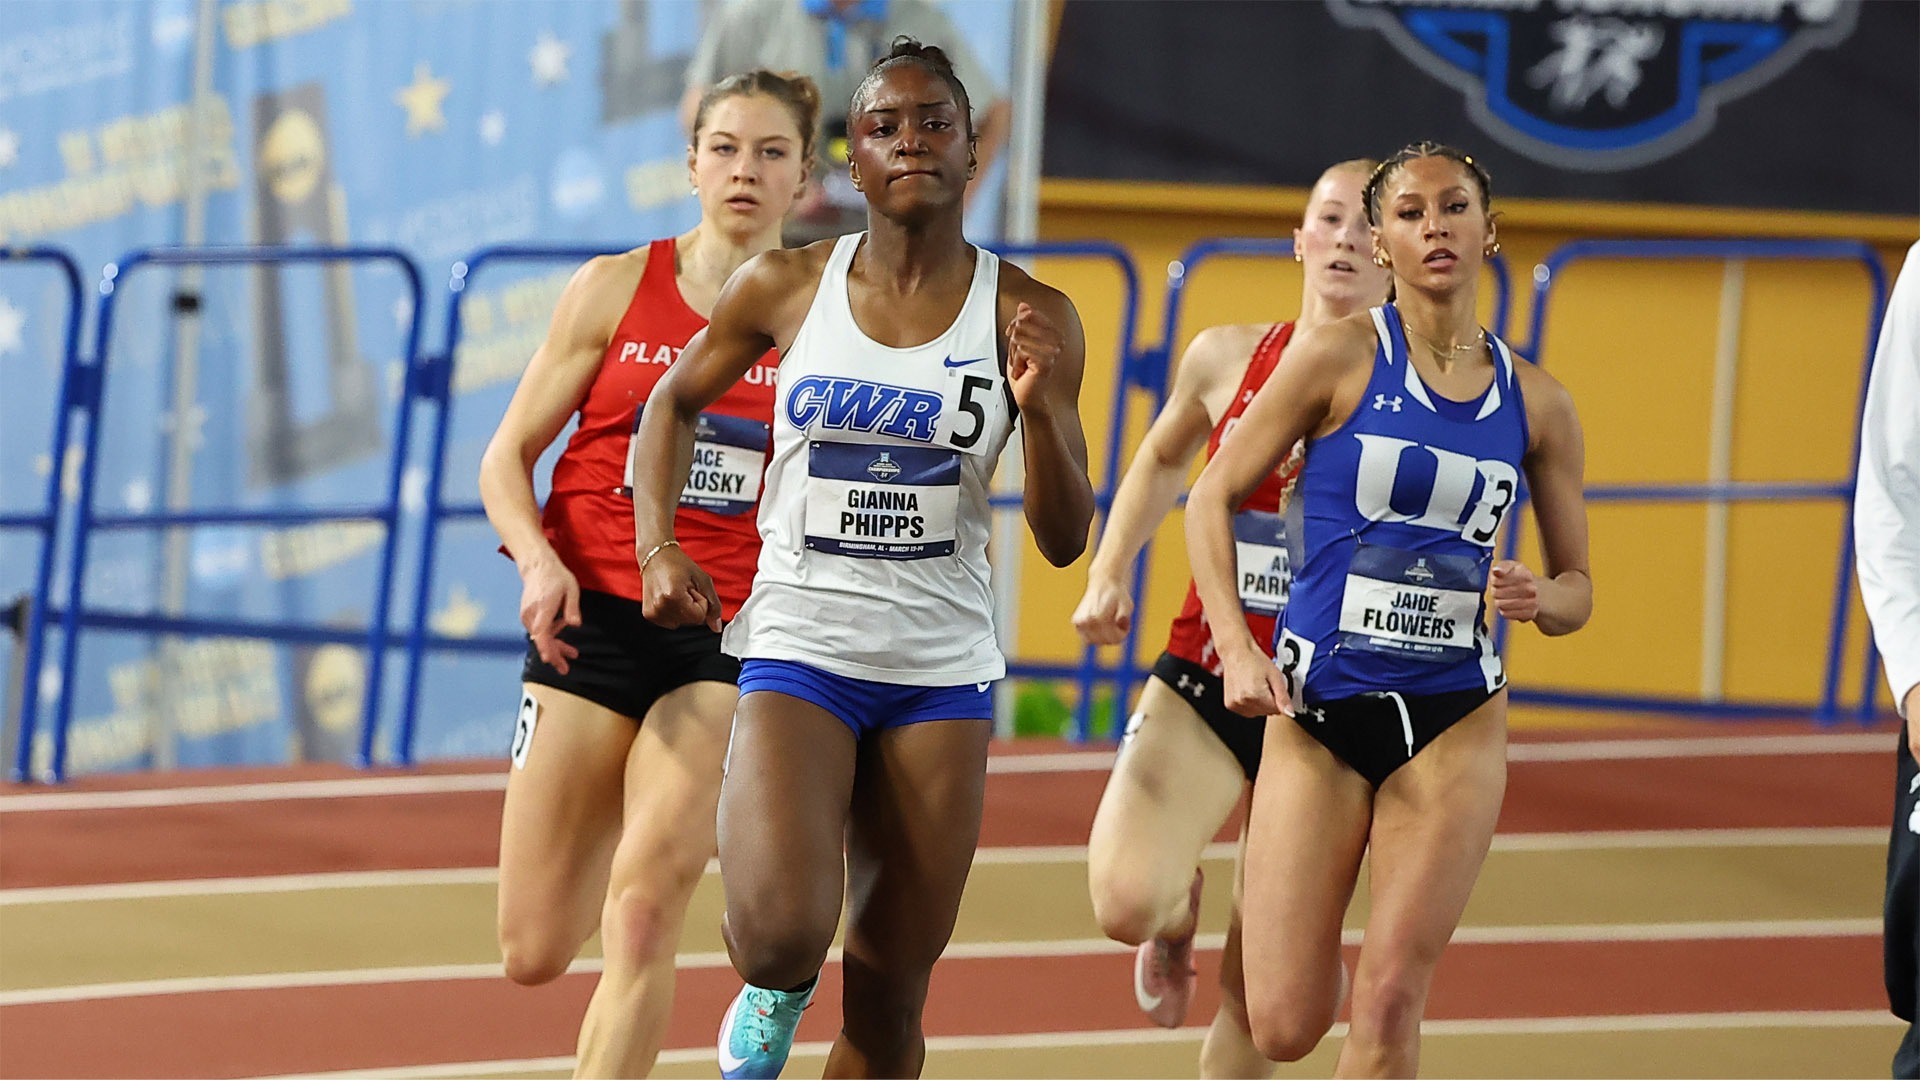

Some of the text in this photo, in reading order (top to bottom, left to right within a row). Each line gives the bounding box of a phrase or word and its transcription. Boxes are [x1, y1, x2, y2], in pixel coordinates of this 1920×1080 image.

[950, 375, 993, 449] 5
[848, 489, 919, 512] GIANNA
[1472, 480, 1513, 543] 3
[840, 511, 925, 539] PHIPPS
[1391, 591, 1440, 613] JAIDE
[1363, 608, 1456, 639] FLOWERS
